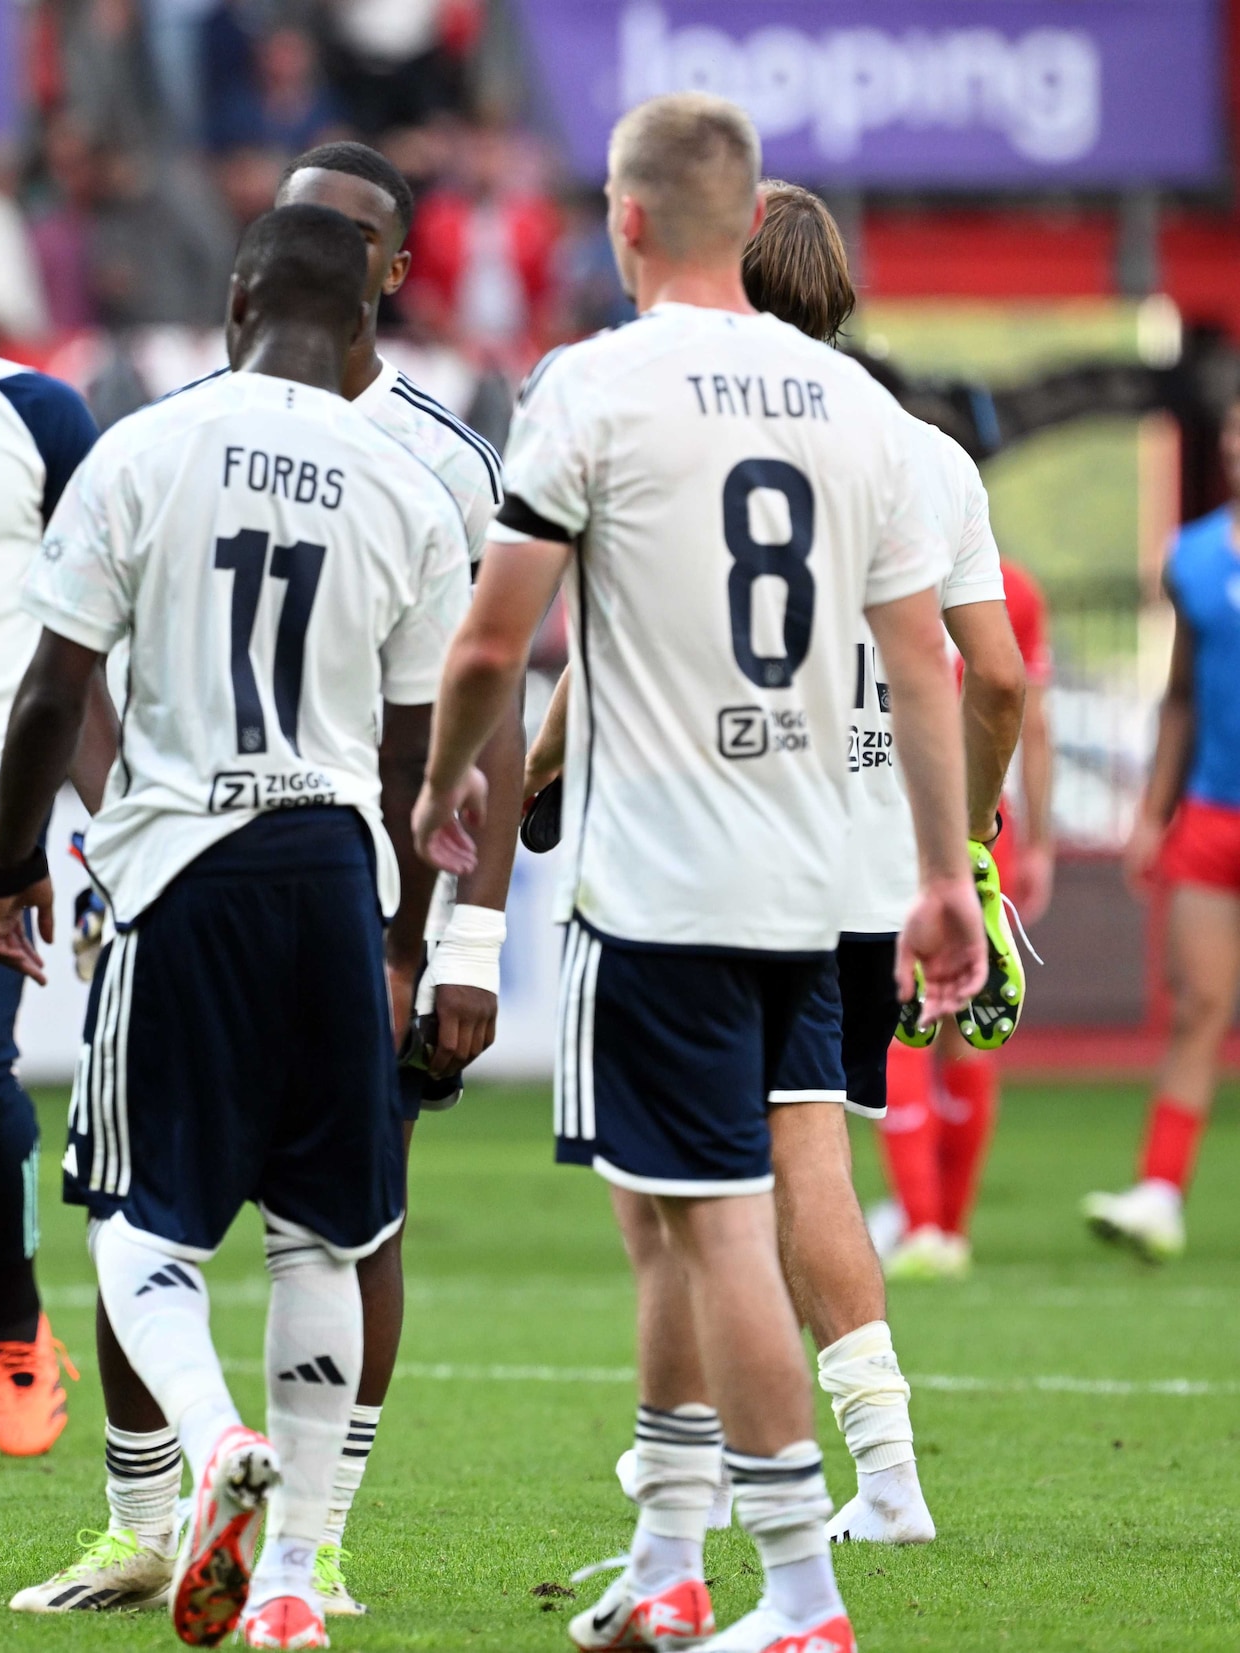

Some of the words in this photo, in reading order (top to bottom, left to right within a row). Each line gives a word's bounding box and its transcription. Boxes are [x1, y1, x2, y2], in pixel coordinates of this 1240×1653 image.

[686, 374, 830, 422] TAYLOR
[223, 446, 345, 510] FORBS
[214, 528, 327, 758] 11
[722, 457, 817, 689] 8
